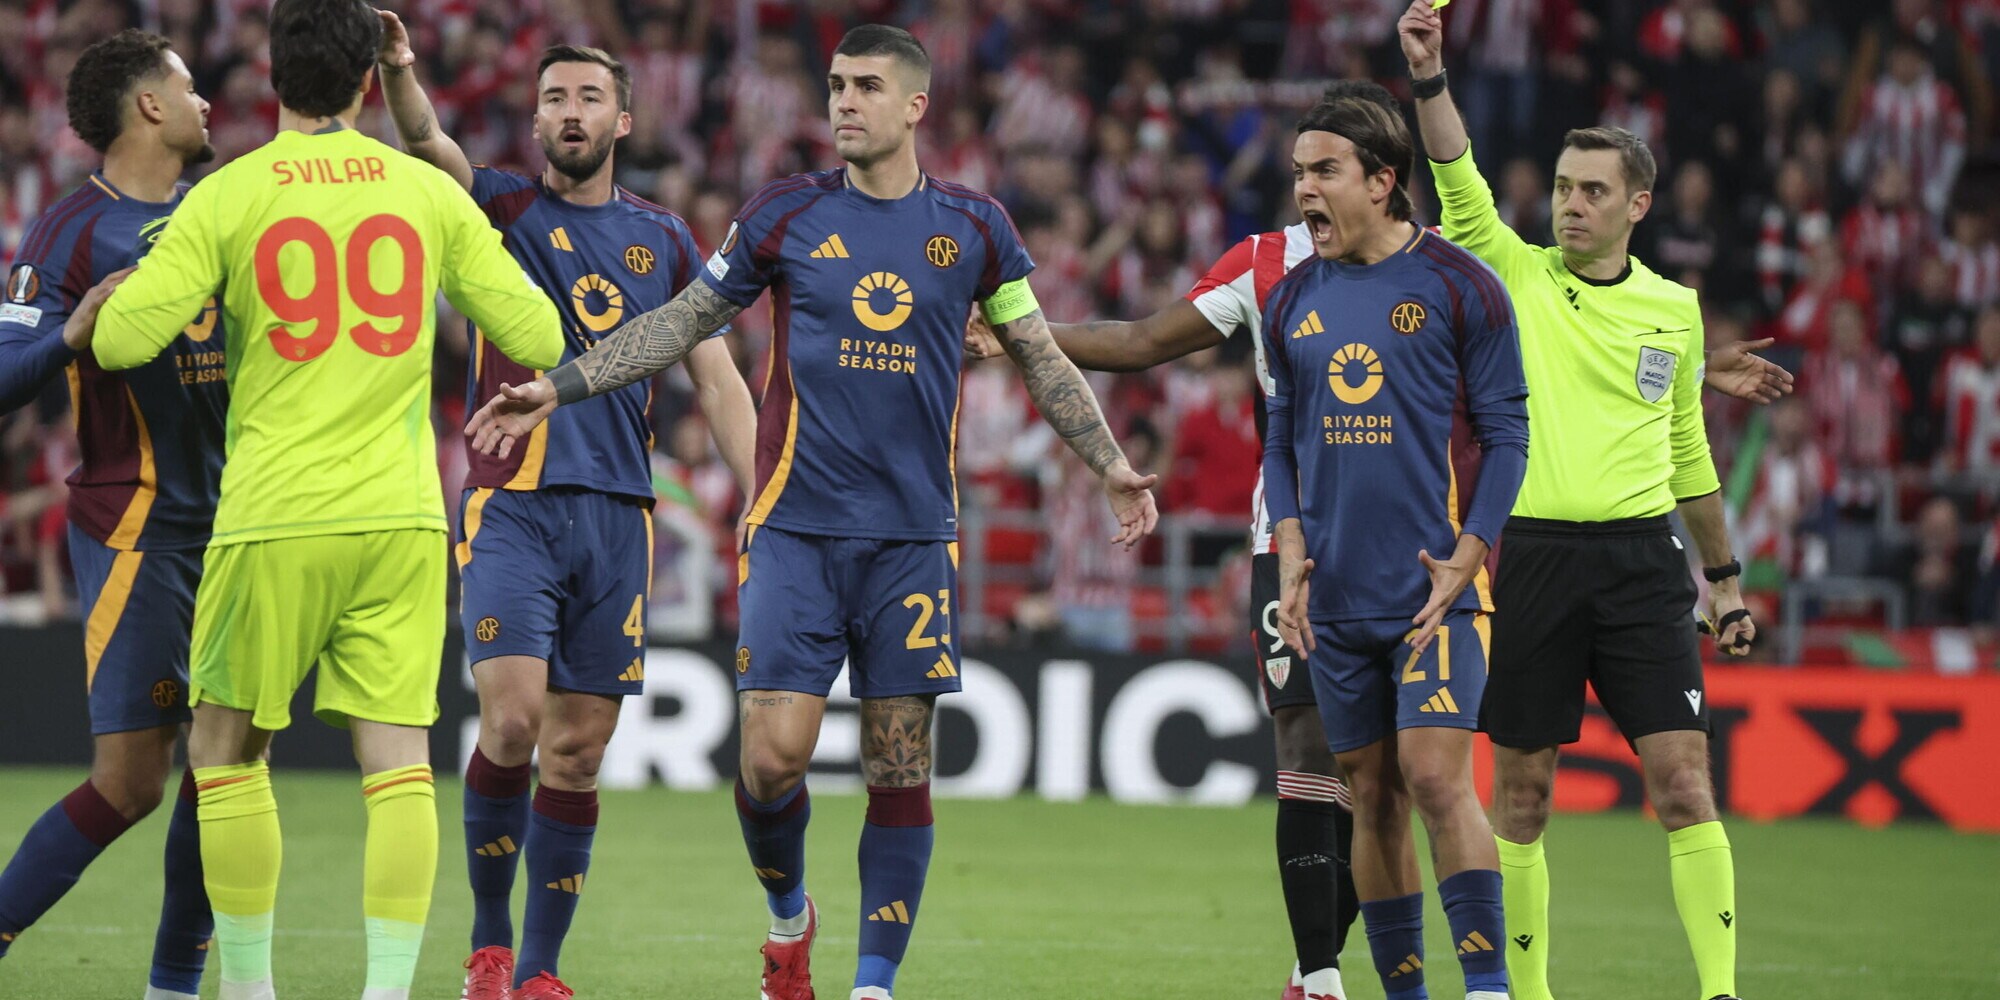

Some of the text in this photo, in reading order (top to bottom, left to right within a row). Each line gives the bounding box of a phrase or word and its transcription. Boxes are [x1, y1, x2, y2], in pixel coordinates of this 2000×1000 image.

[272, 157, 386, 186] SVILAR
[254, 213, 425, 363] 99
[840, 338, 916, 358] RIYADH
[838, 354, 916, 374] SEASON
[1323, 415, 1392, 428] RIYADH
[1325, 431, 1392, 445] SEASON
[622, 594, 644, 647] 4
[1262, 599, 1286, 654] 9
[1401, 624, 1451, 685] 21
